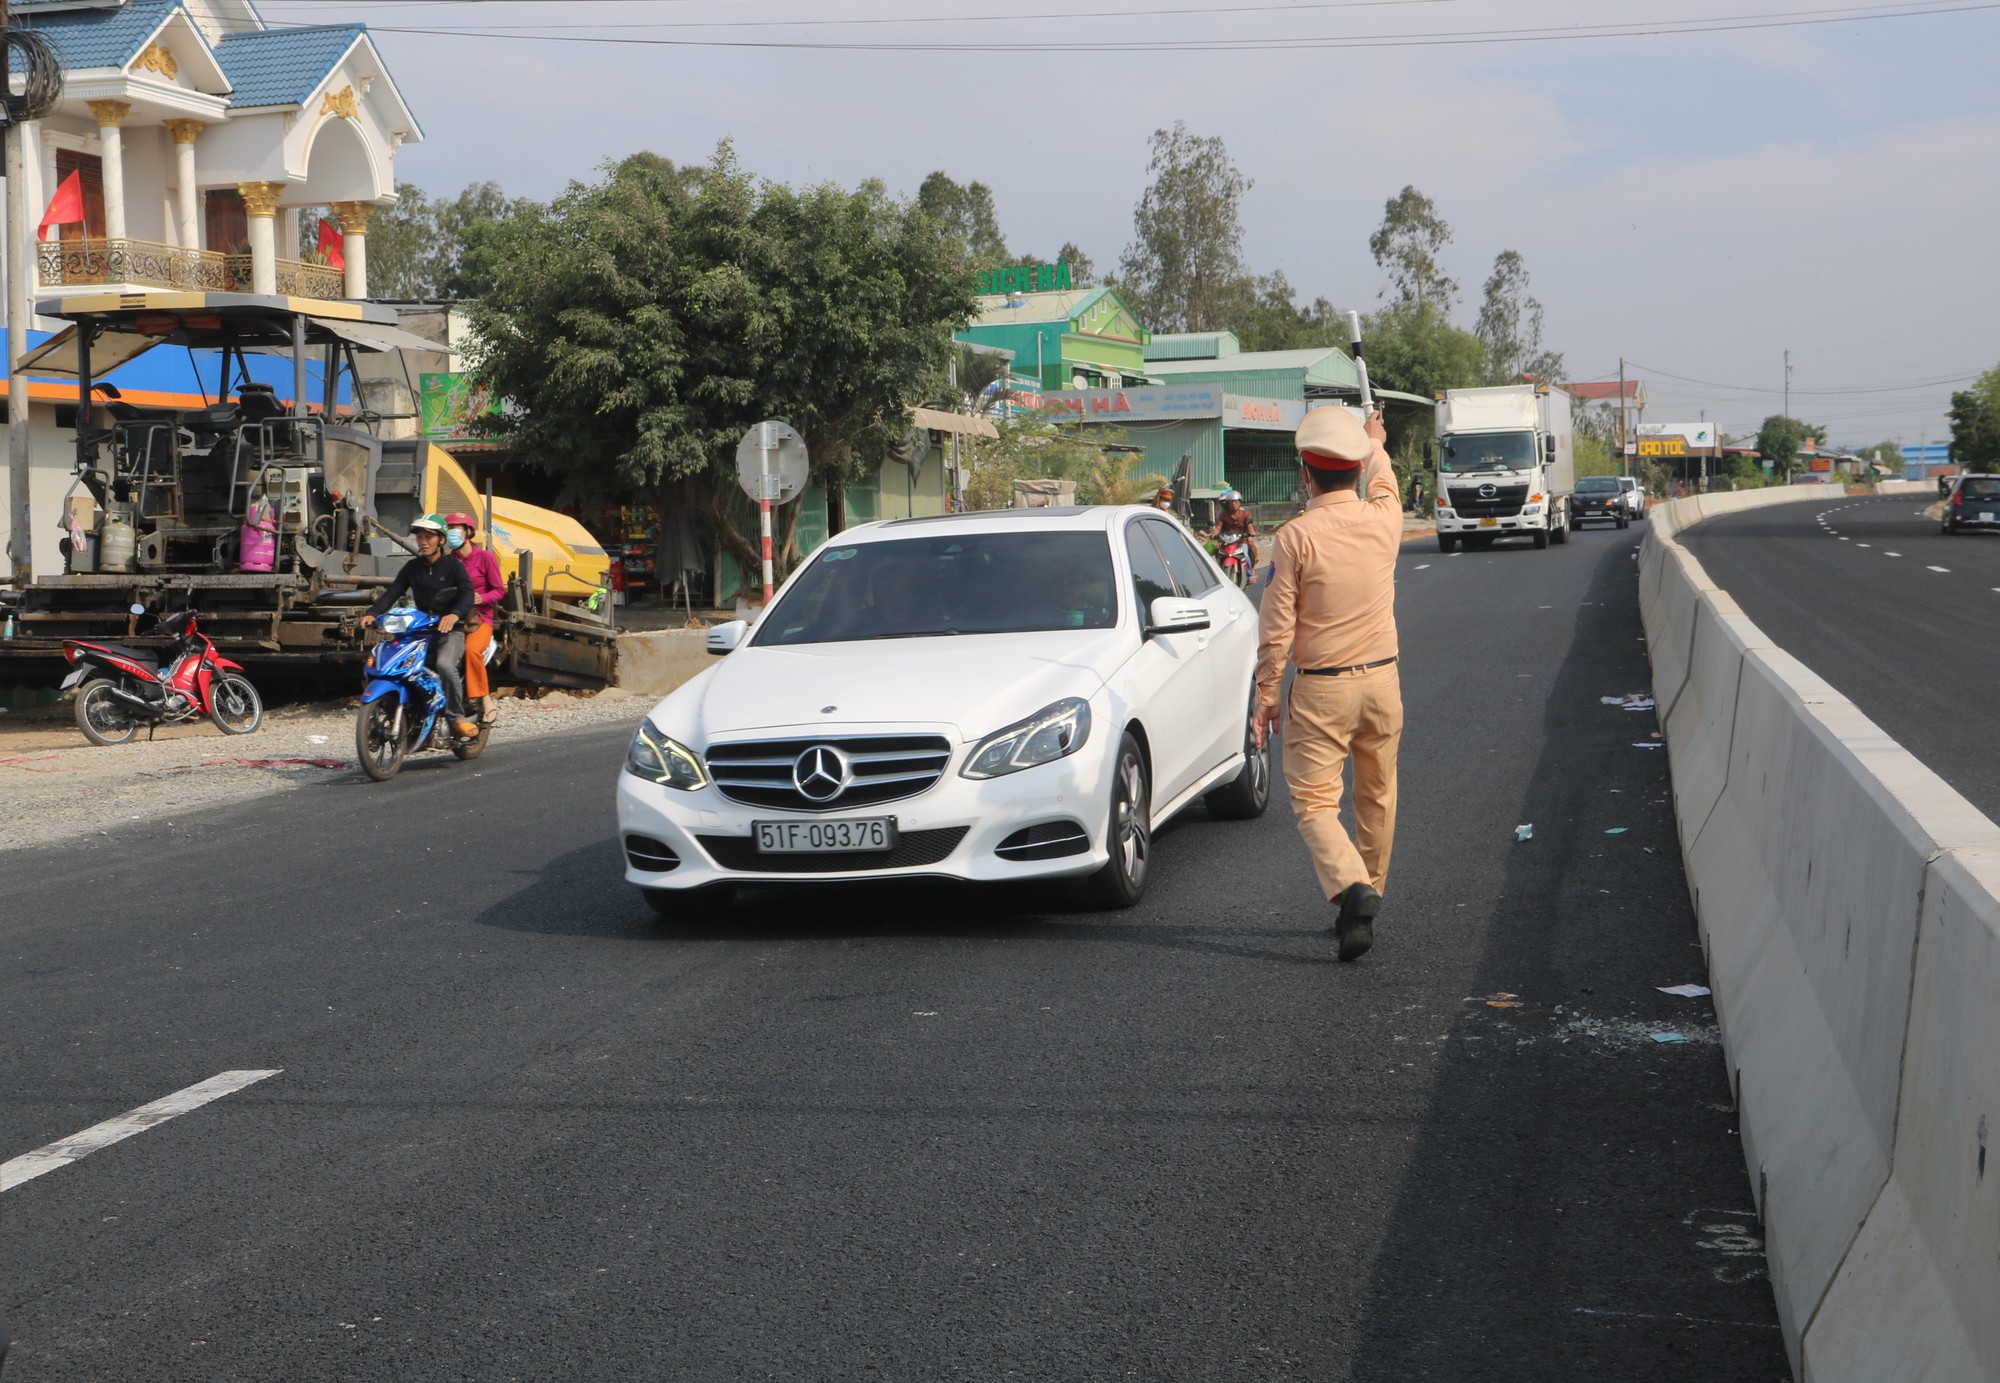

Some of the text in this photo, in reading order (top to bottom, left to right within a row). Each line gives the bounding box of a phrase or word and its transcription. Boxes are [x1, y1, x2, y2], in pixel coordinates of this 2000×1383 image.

[1037, 256, 1072, 291] HÀ
[1092, 391, 1131, 413] HÀ
[1638, 441, 1661, 456] CAO
[760, 822, 884, 849] 51F-093.76
